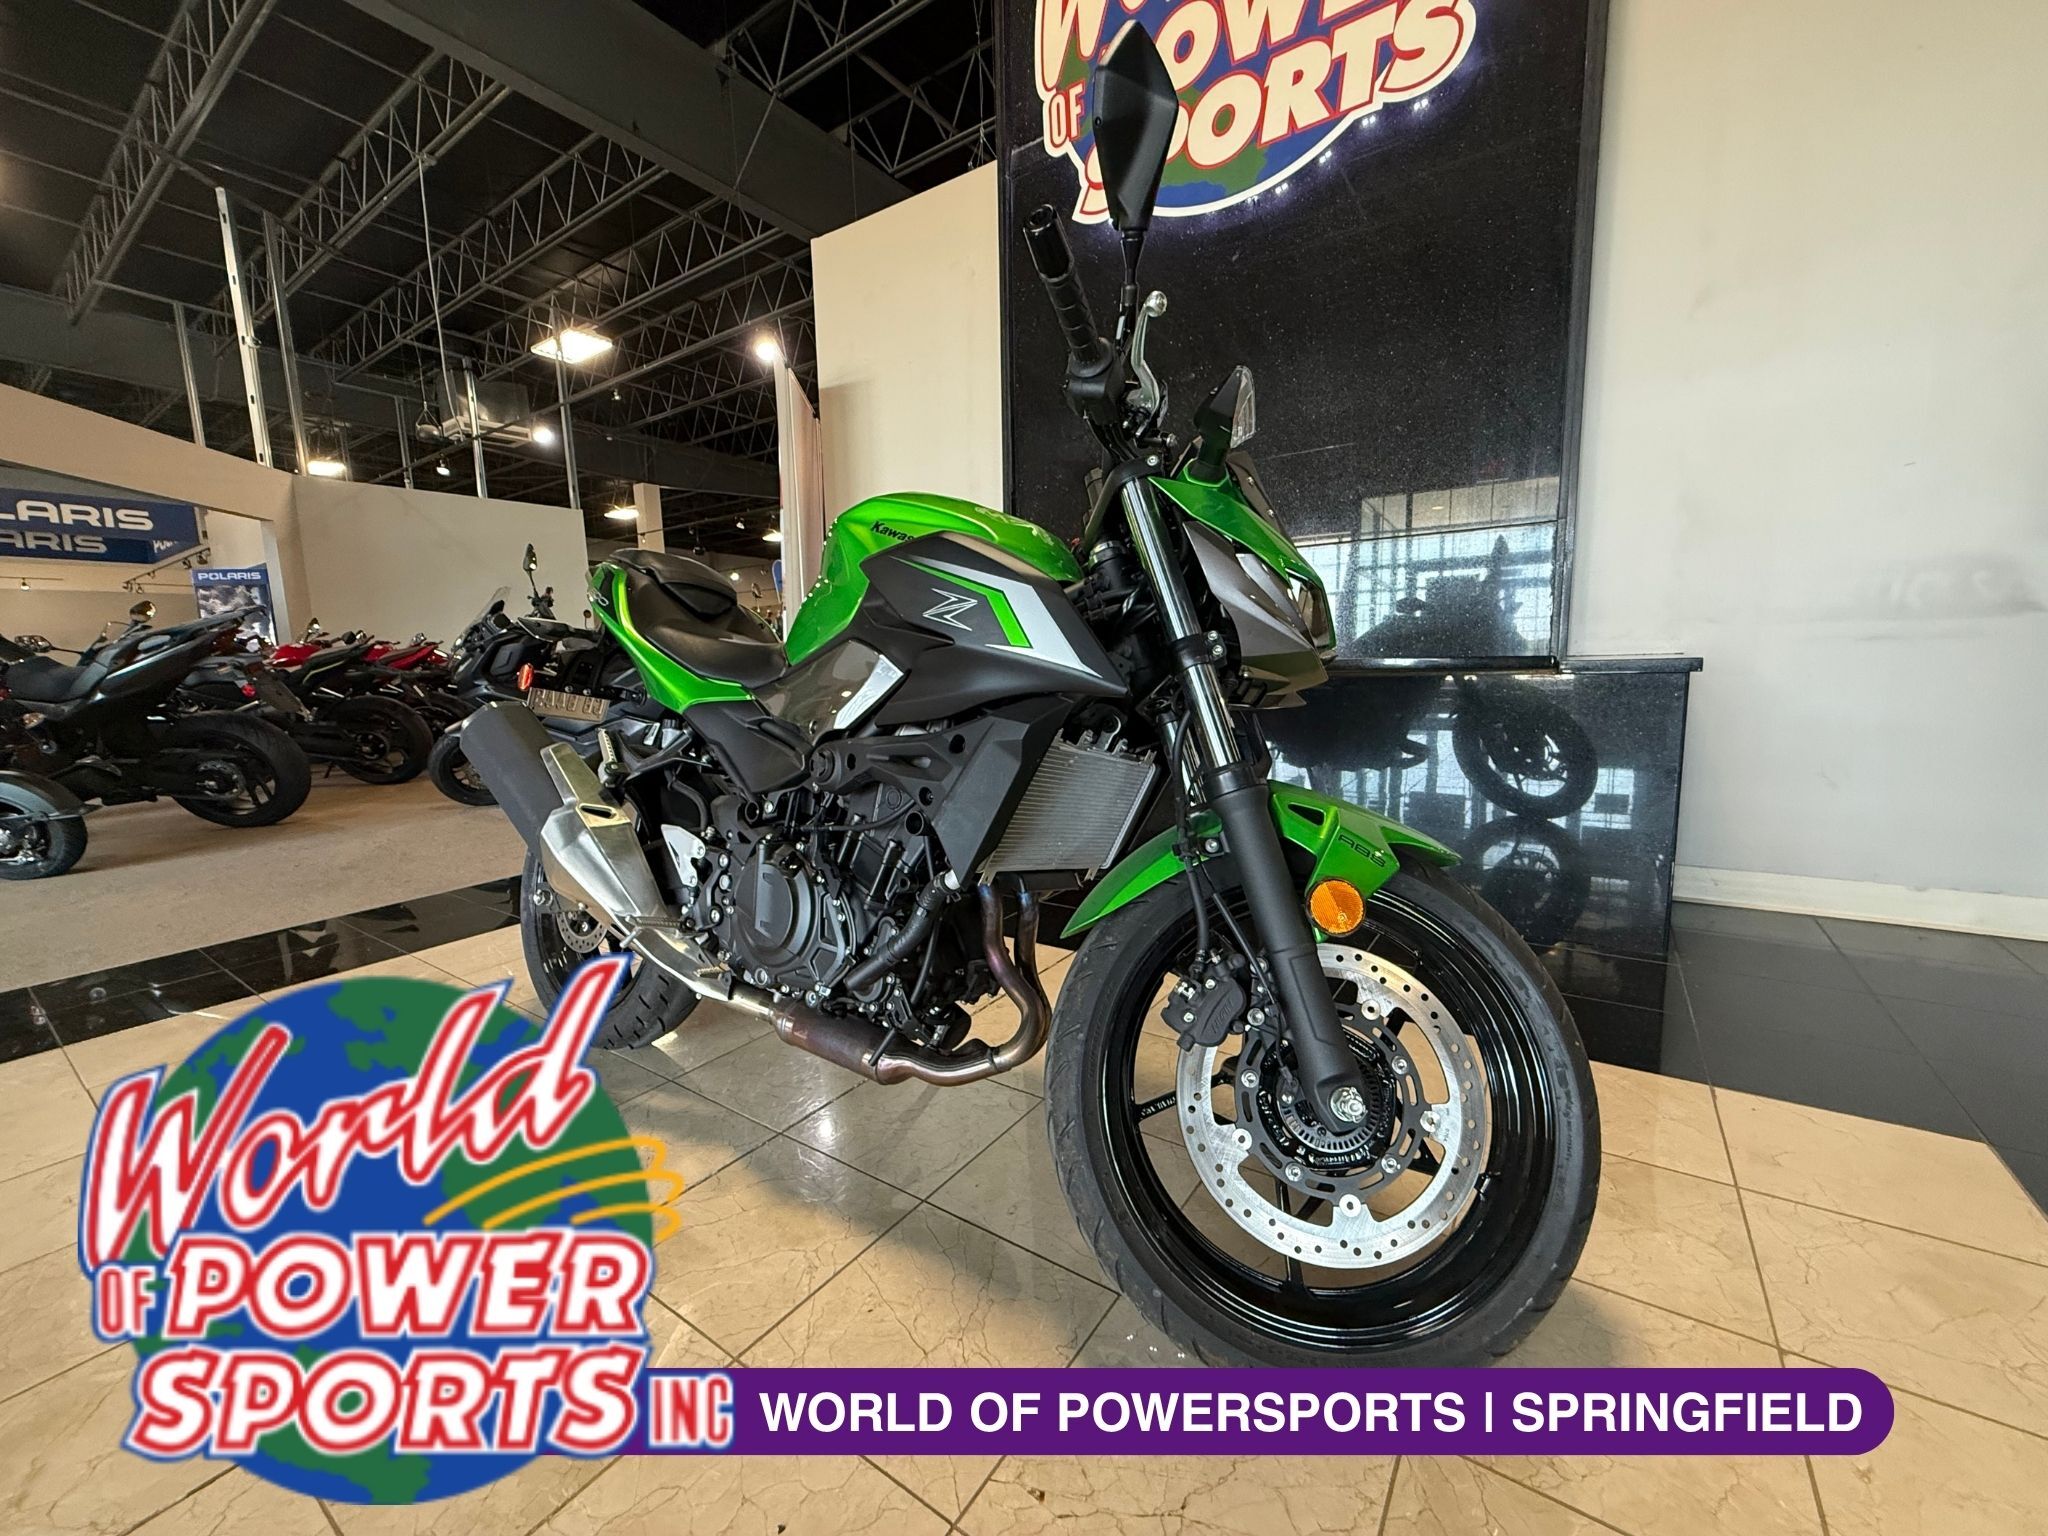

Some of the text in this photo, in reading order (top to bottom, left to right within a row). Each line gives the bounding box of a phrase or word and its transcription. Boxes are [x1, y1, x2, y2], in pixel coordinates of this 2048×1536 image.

[1048, 83, 1084, 148] OF
[1079, 0, 1463, 215] ORTS
[197, 571, 261, 581] POLARIS
[1338, 835, 1386, 867] ABS
